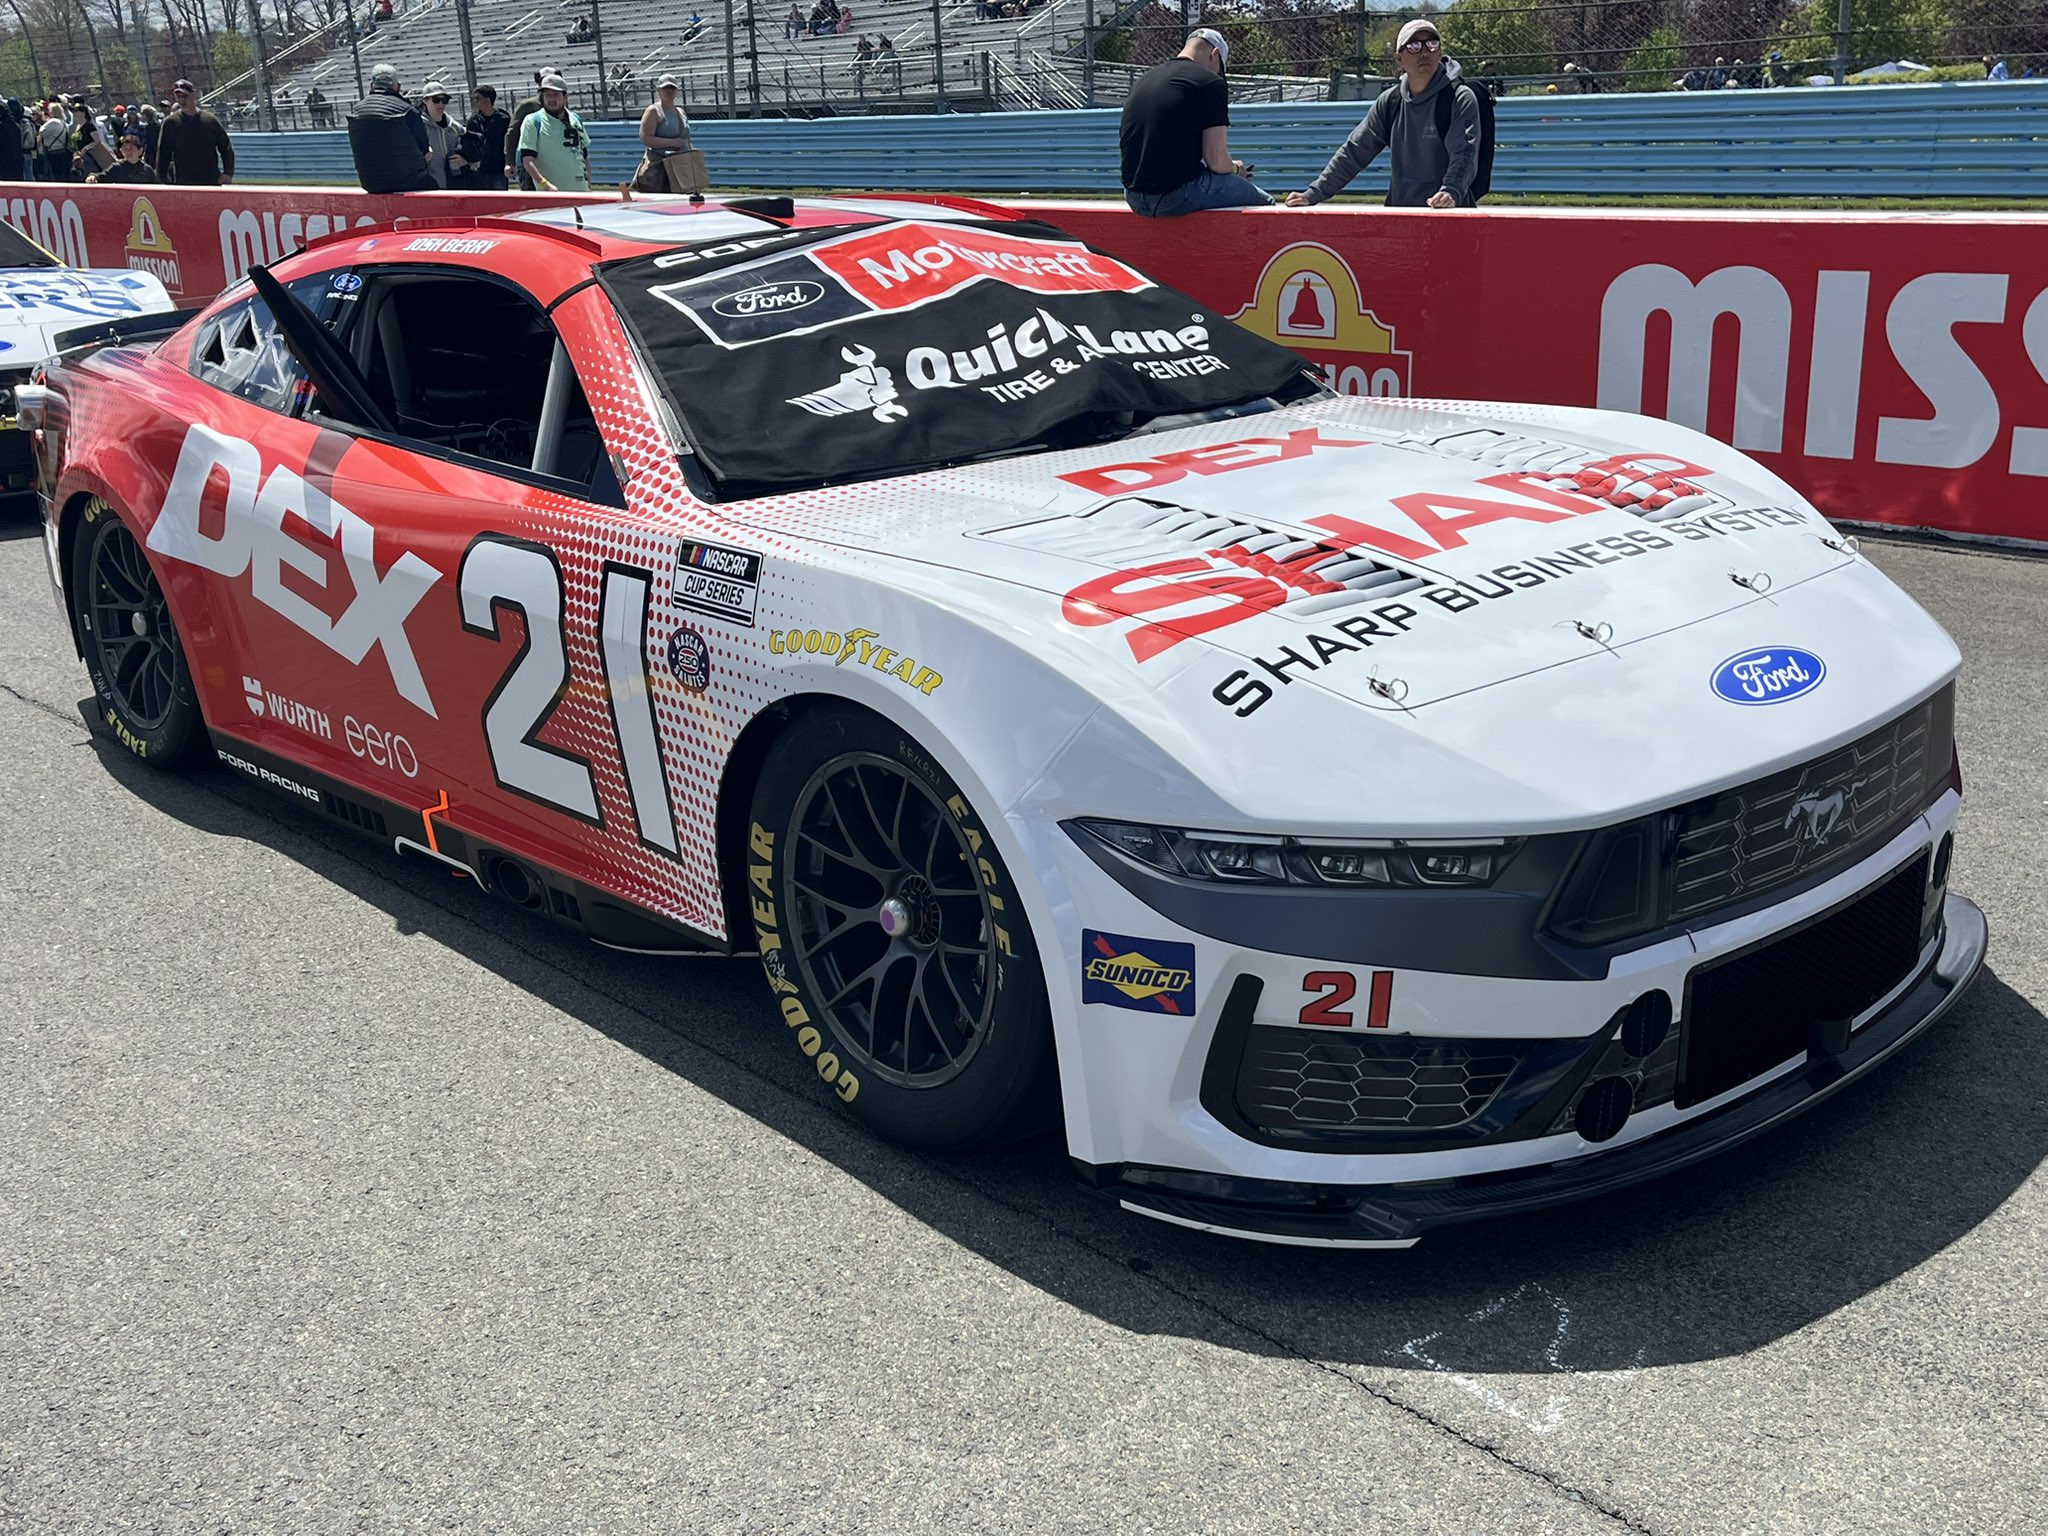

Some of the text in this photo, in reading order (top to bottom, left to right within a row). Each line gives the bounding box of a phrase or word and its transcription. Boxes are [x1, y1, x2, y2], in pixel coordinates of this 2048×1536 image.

[402, 237, 500, 255] JOSH BERRY
[857, 239, 1101, 290] Motorcraft
[734, 285, 808, 314] Ford
[980, 353, 1231, 403] TIRE & CENTER
[1597, 263, 2048, 478] MIS
[1055, 427, 1377, 497] DEX
[146, 423, 443, 720] DEX
[702, 548, 749, 577] NASCAR
[684, 575, 744, 605] CUP SERIES
[674, 634, 704, 657] NASCAR
[1211, 602, 1418, 718] SHARP
[1420, 528, 1675, 614] BUSINESS
[674, 667, 706, 688] SALUTES
[680, 655, 698, 667] 250
[769, 628, 943, 696] GOODYEAR
[1730, 653, 1811, 699] Ford
[456, 531, 684, 864] 21
[107, 708, 148, 758] EAGLE
[344, 714, 419, 778] eero
[217, 749, 320, 802] FORD RACING
[946, 794, 1012, 957] EAGLE
[749, 821, 860, 1103] GOODYEAR
[1089, 960, 1186, 990] SUNOCO
[1299, 970, 1394, 1028] 21
